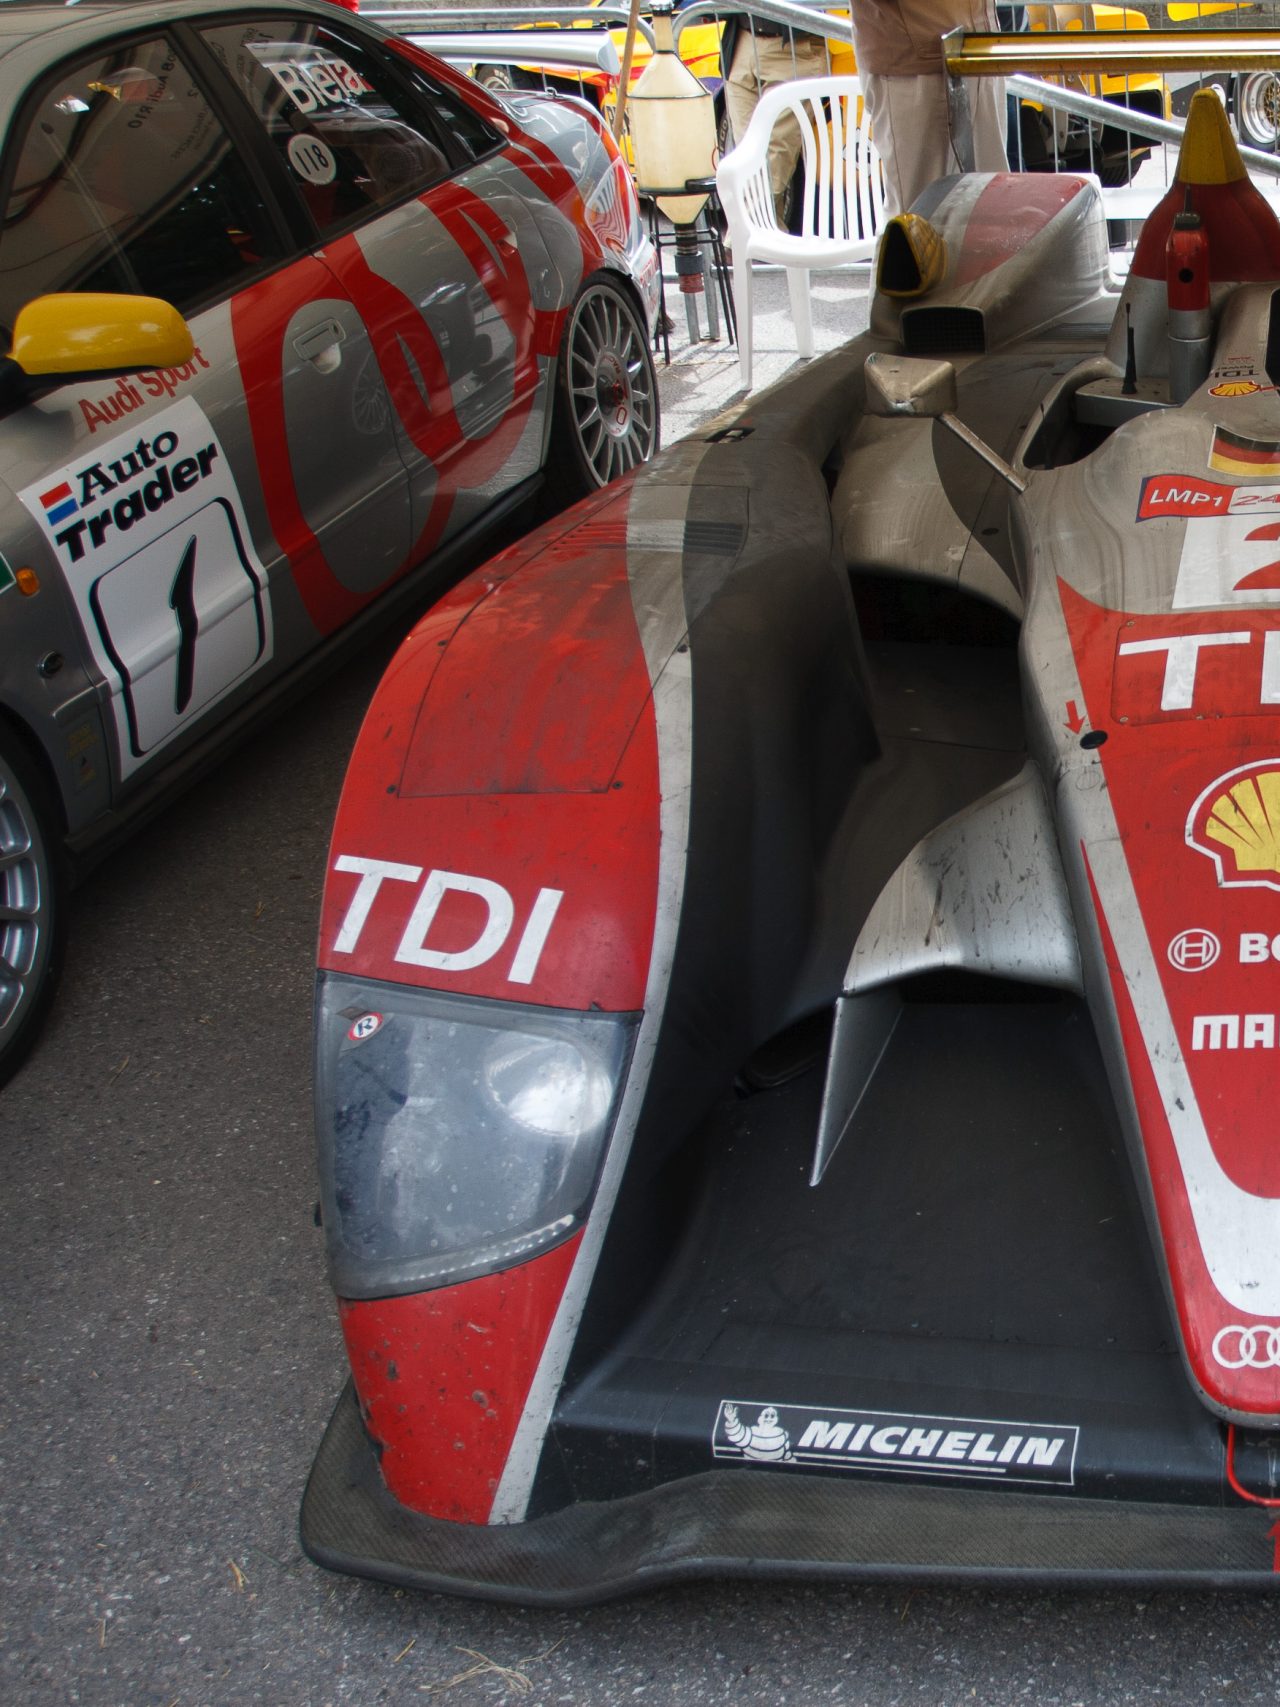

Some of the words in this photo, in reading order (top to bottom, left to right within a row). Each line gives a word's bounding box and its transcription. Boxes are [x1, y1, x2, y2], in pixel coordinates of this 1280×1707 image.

[268, 52, 367, 115] Biela
[295, 144, 329, 175] 118
[79, 376, 146, 434] Audi
[137, 346, 210, 398] Sport
[1214, 370, 1260, 378] TDI
[56, 442, 218, 563] Trader
[76, 431, 179, 508] Auto
[1149, 488, 1223, 507] LMP1
[169, 534, 197, 714] 1
[333, 855, 564, 985] TDI
[798, 1420, 1065, 1466] MICHELIN
